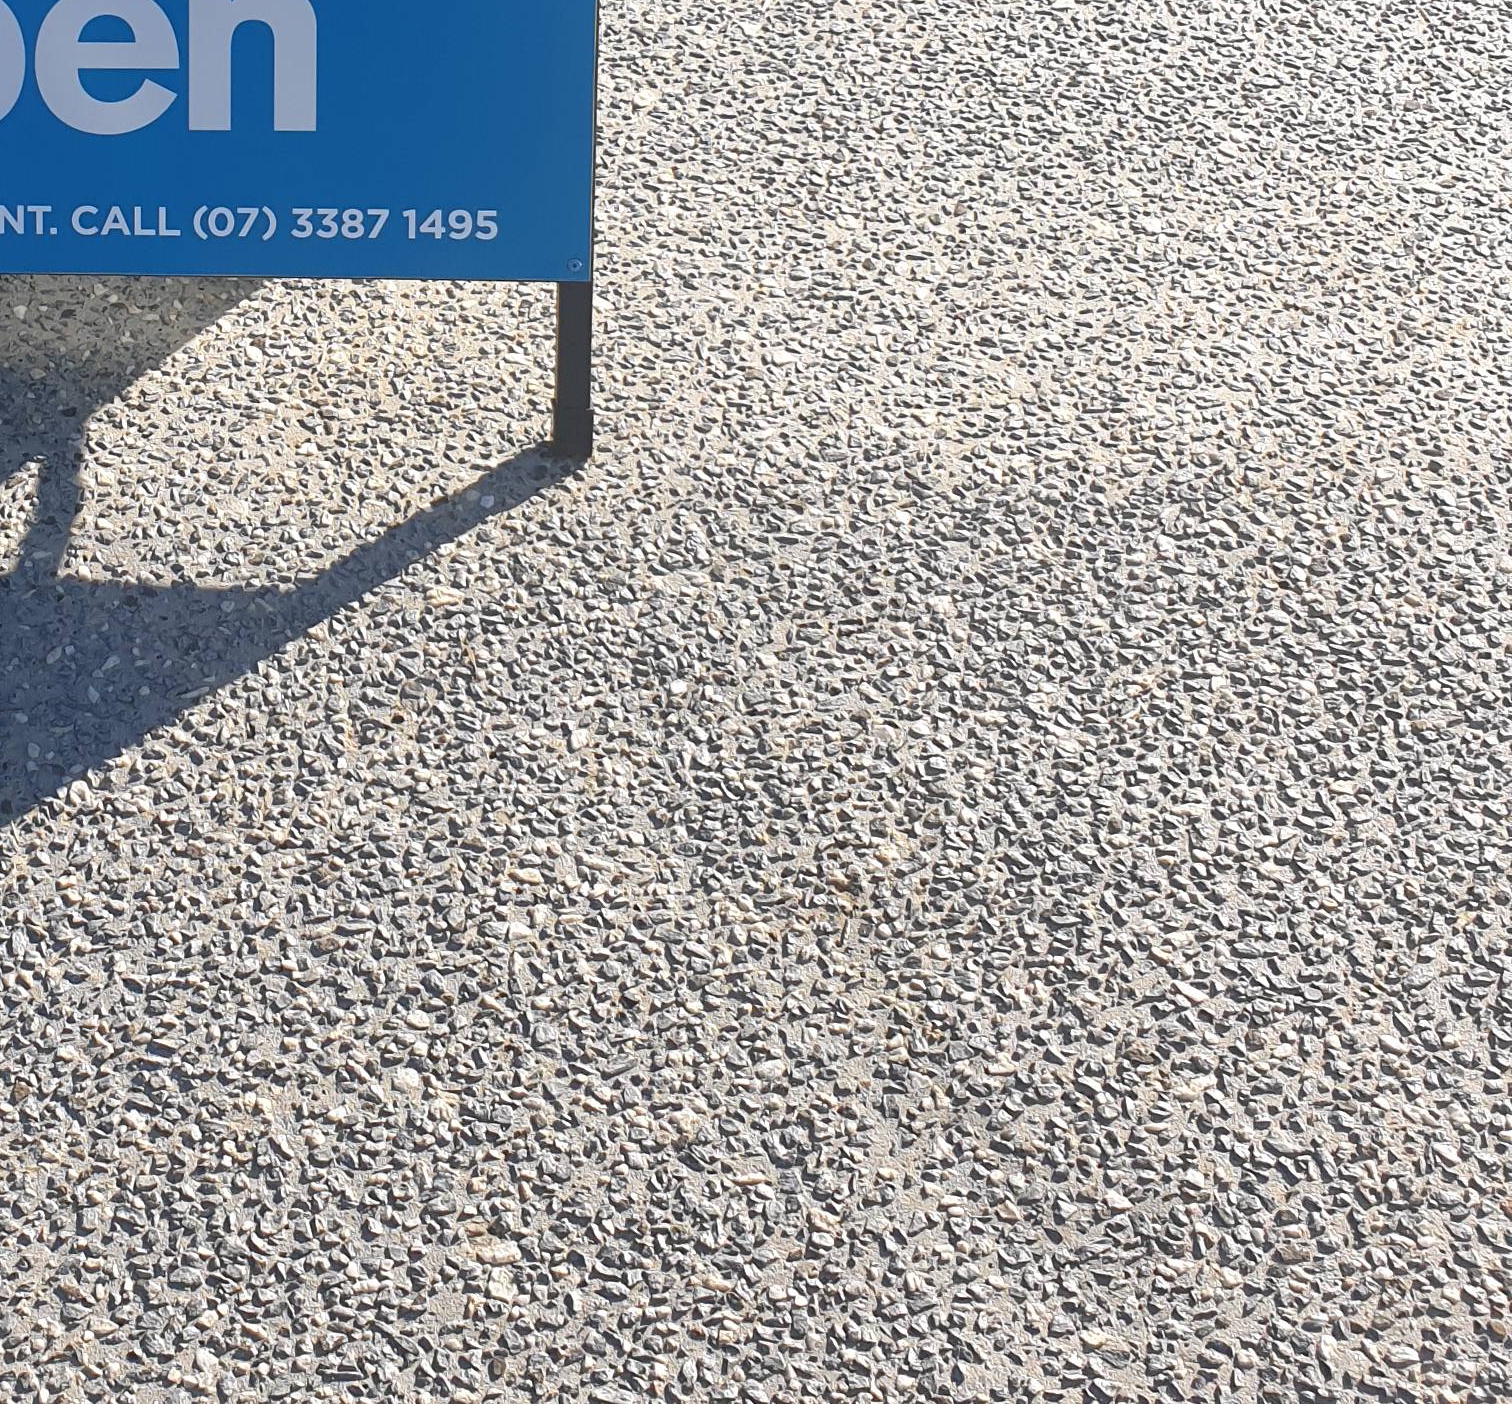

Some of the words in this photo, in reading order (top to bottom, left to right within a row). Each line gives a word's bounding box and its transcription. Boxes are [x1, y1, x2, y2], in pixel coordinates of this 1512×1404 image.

[71, 205, 181, 236] CALL
[193, 205, 277, 241] (07)
[290, 208, 390, 239] 3387
[402, 209, 498, 240] 1495
